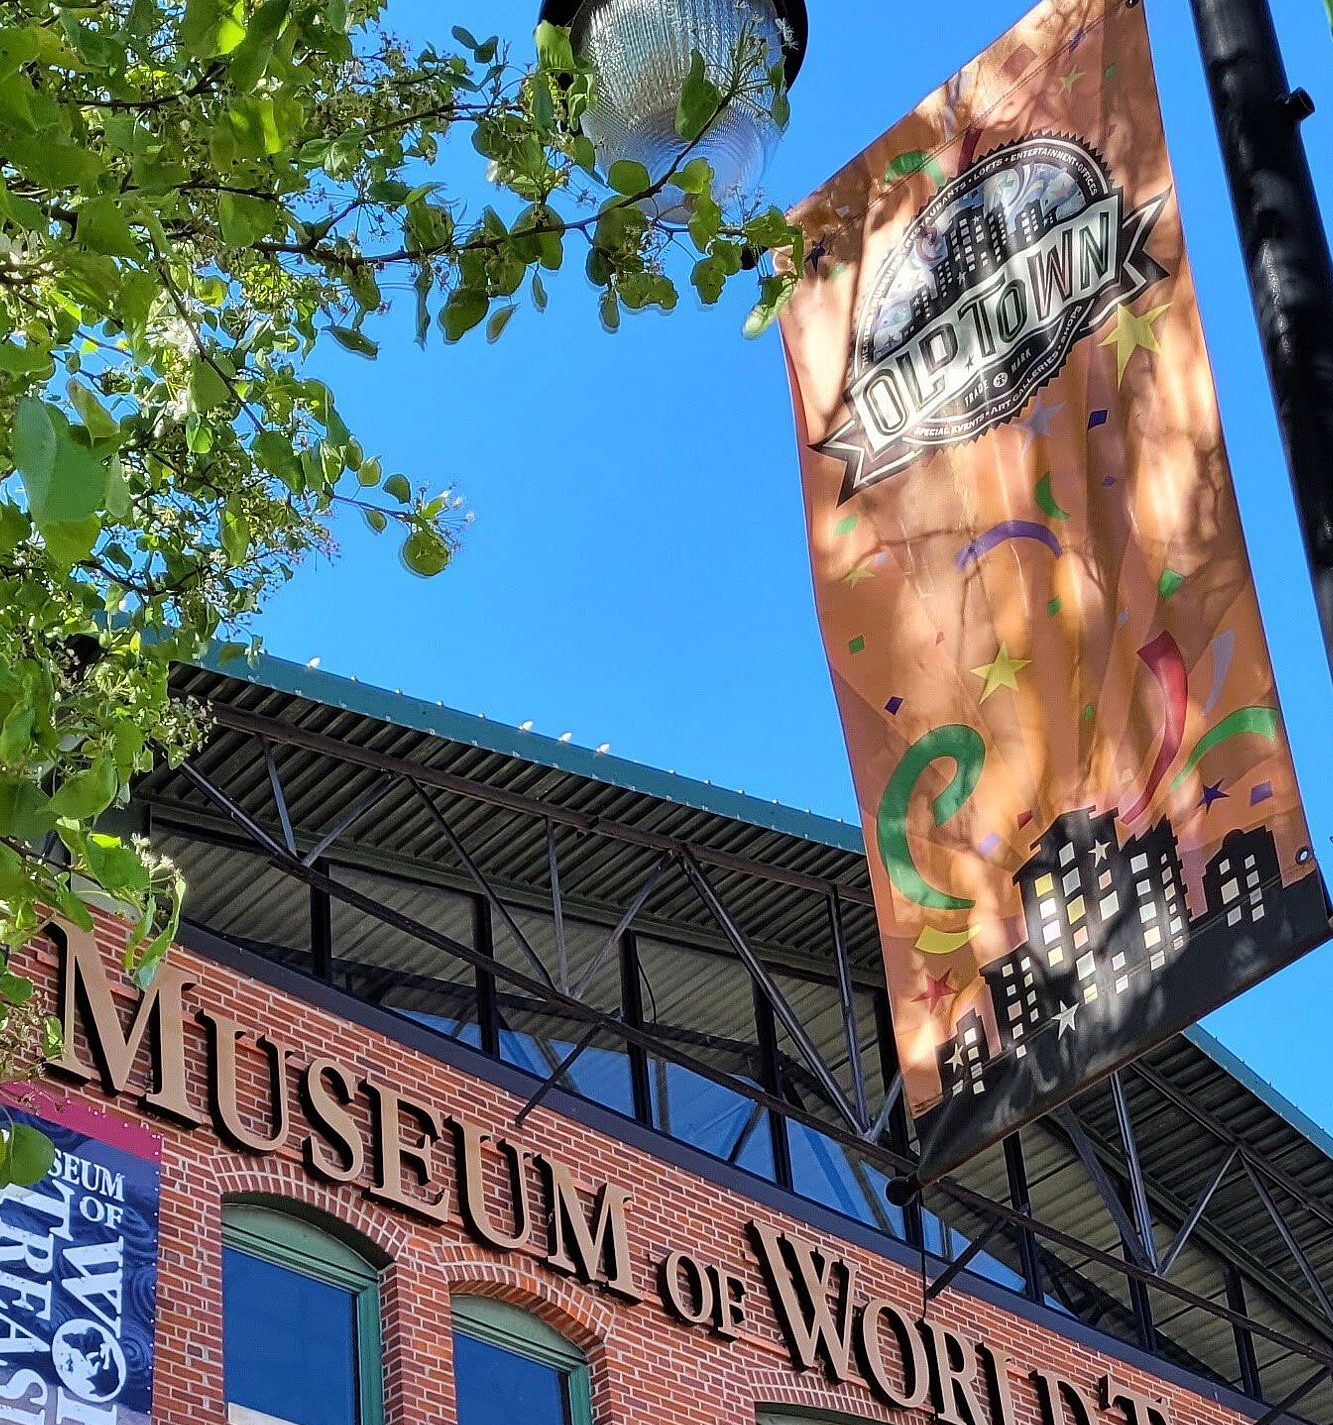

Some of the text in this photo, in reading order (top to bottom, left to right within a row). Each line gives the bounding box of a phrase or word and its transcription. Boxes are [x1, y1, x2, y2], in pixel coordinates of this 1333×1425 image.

[973, 159, 1003, 181] LOFTS
[1010, 147, 1077, 166] ENTERTAINMENT
[1077, 163, 1098, 197] OFFICES
[957, 211, 1110, 359] TOWN
[913, 305, 1083, 437] SPECIAL EVENTS ART GALLERIES SHOPS
[964, 348, 1031, 407] TRADE MARK
[46, 917, 643, 1303] MUSEUM
[659, 1249, 746, 1340] OF
[79, 1196, 124, 1230] OF
